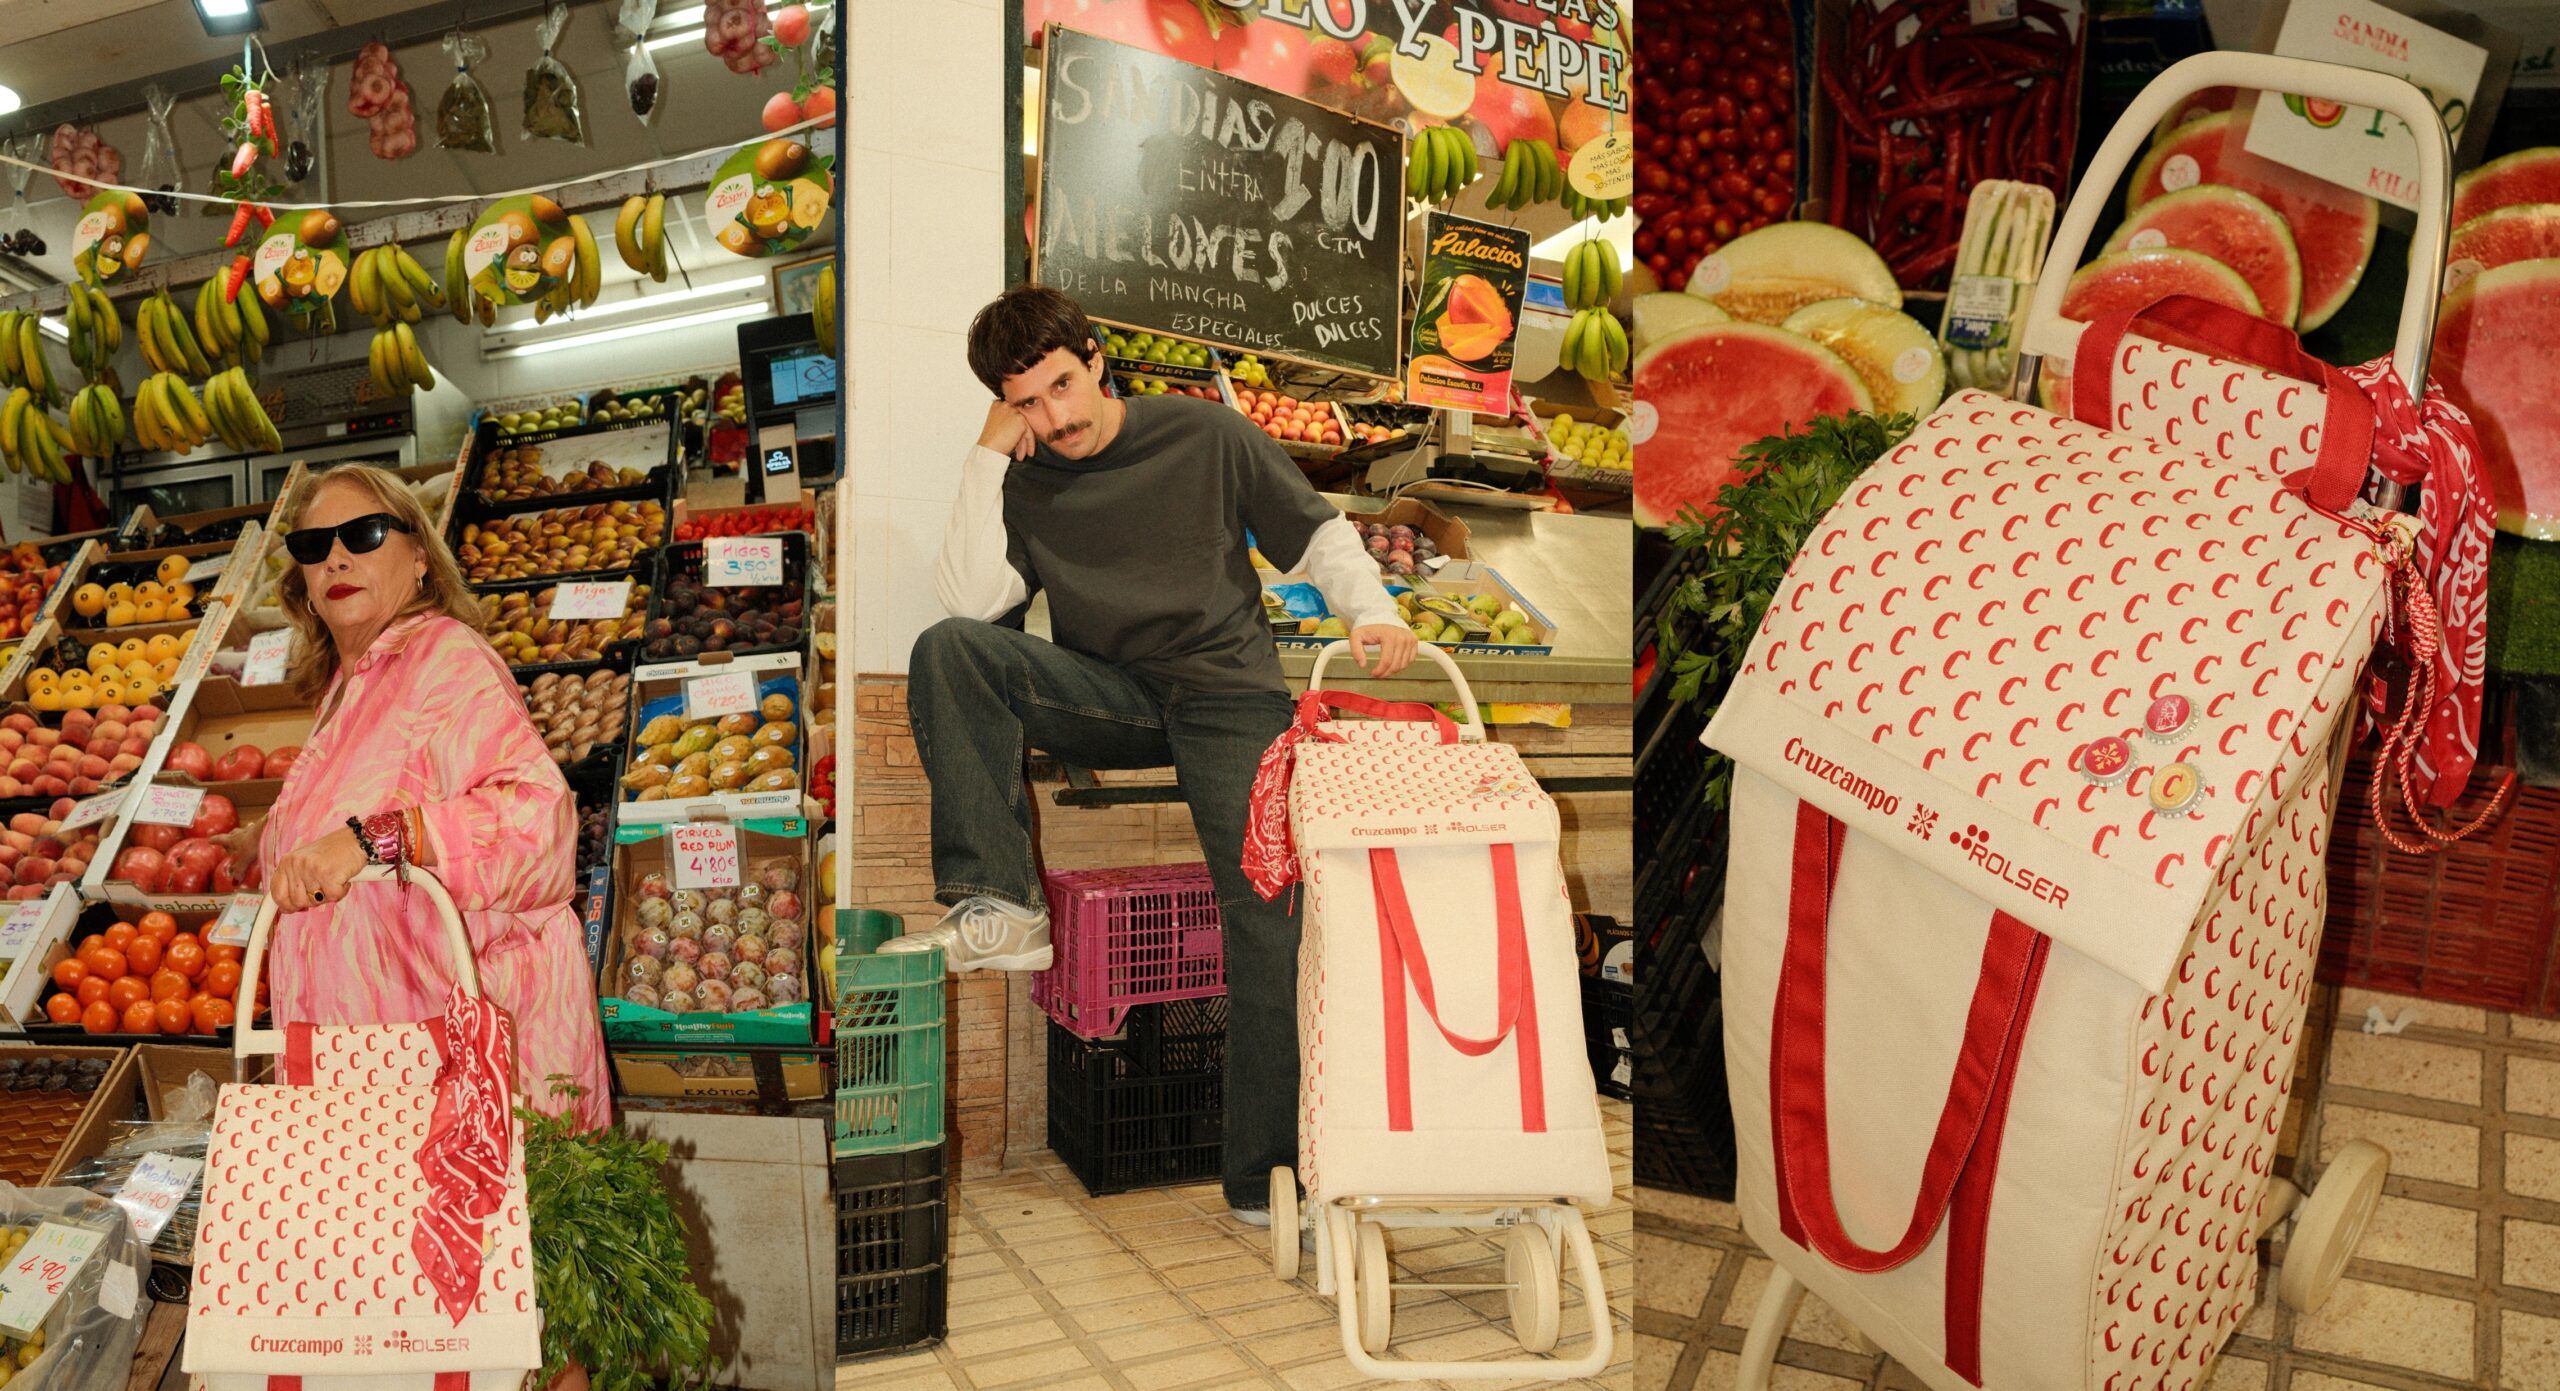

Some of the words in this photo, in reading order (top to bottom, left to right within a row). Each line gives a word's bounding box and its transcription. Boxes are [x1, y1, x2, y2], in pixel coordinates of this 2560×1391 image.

[1454, 6, 1629, 113] PEPE
[716, 190, 750, 209] Zespri
[1042, 185, 1294, 292] MELONES
[1430, 232, 1523, 269] Palacios
[1101, 275, 1128, 296] LA
[1150, 276, 1246, 313] MANCHA
[1171, 312, 1283, 347] ESPECIALES
[1420, 374, 1446, 385] Palacios
[1351, 826, 1418, 837] Cruzcampo
[1457, 823, 1508, 834] ROLSER
[1784, 736, 1900, 816] Cruzcampo
[1968, 843, 2070, 910] ROLSER
[680, 841, 705, 852] RED
[708, 839, 736, 852] PLUM
[588, 894, 605, 922] Sol
[251, 1334, 344, 1357] Cruzcampo
[400, 1337, 471, 1353] ROLSER
